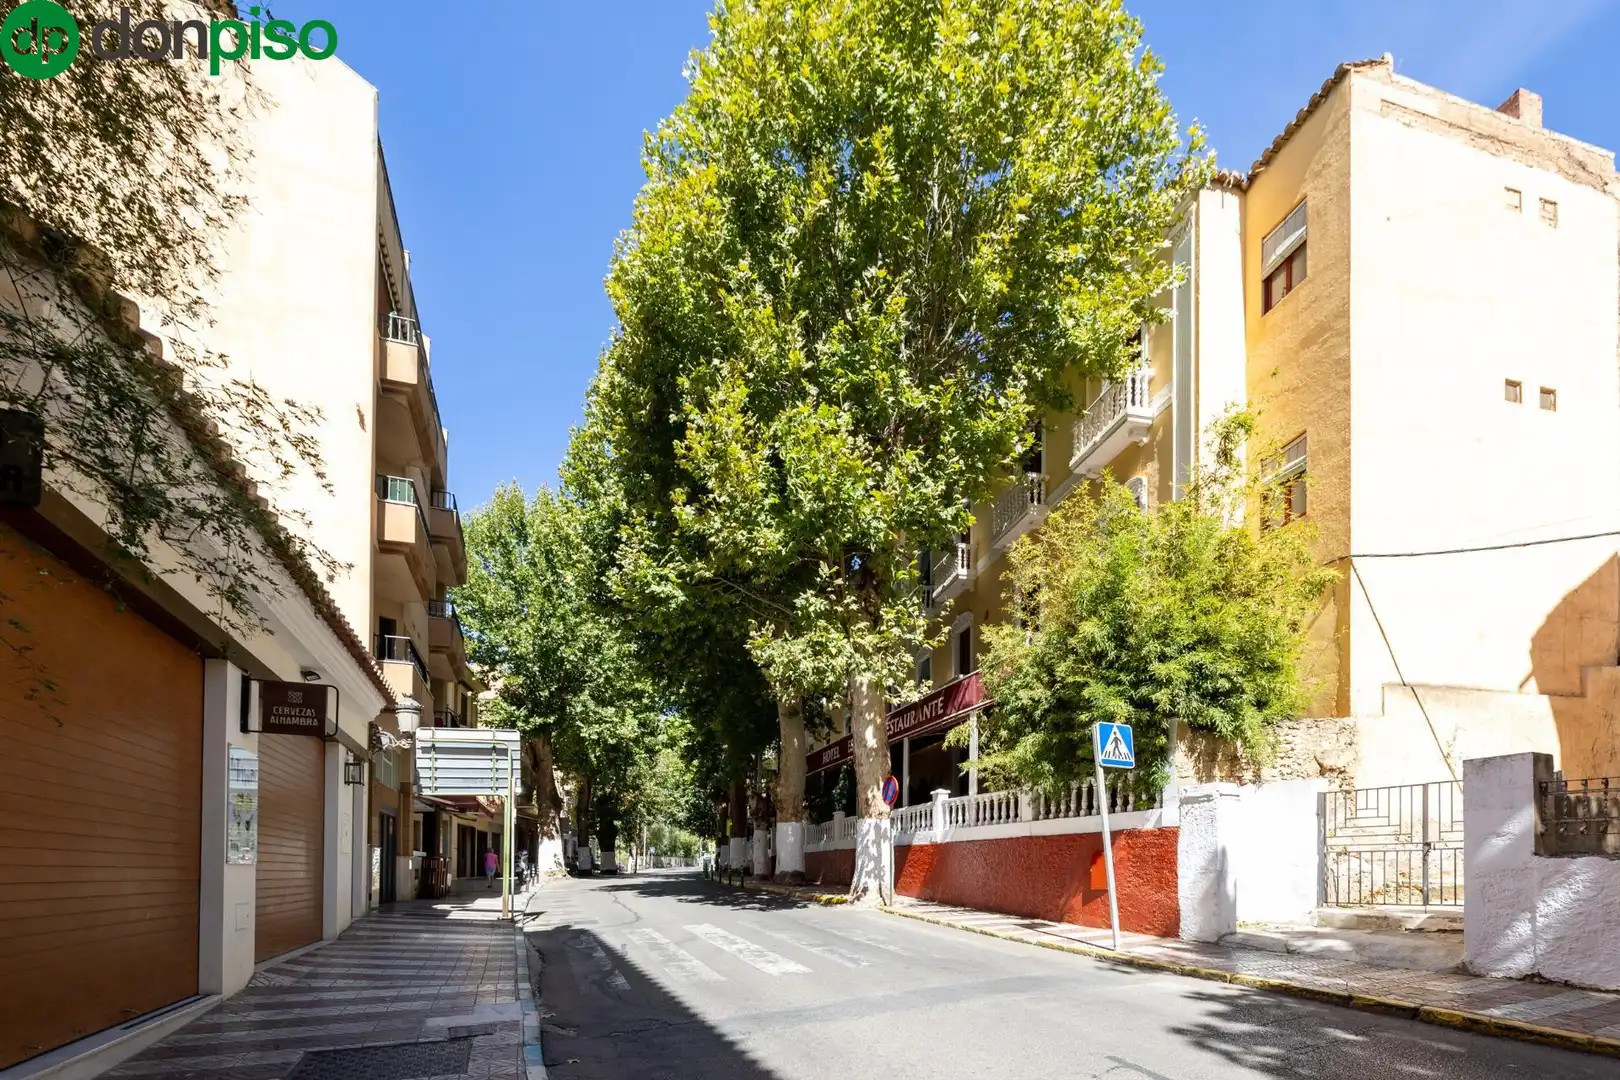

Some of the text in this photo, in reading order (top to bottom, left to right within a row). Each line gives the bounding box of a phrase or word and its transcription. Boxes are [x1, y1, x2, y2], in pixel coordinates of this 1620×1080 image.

[272, 706, 316, 717] CERVEZAS
[270, 715, 318, 726] ALHAMBRA
[822, 746, 841, 764] HOTEL
[886, 696, 945, 735] ESTAURANTE
